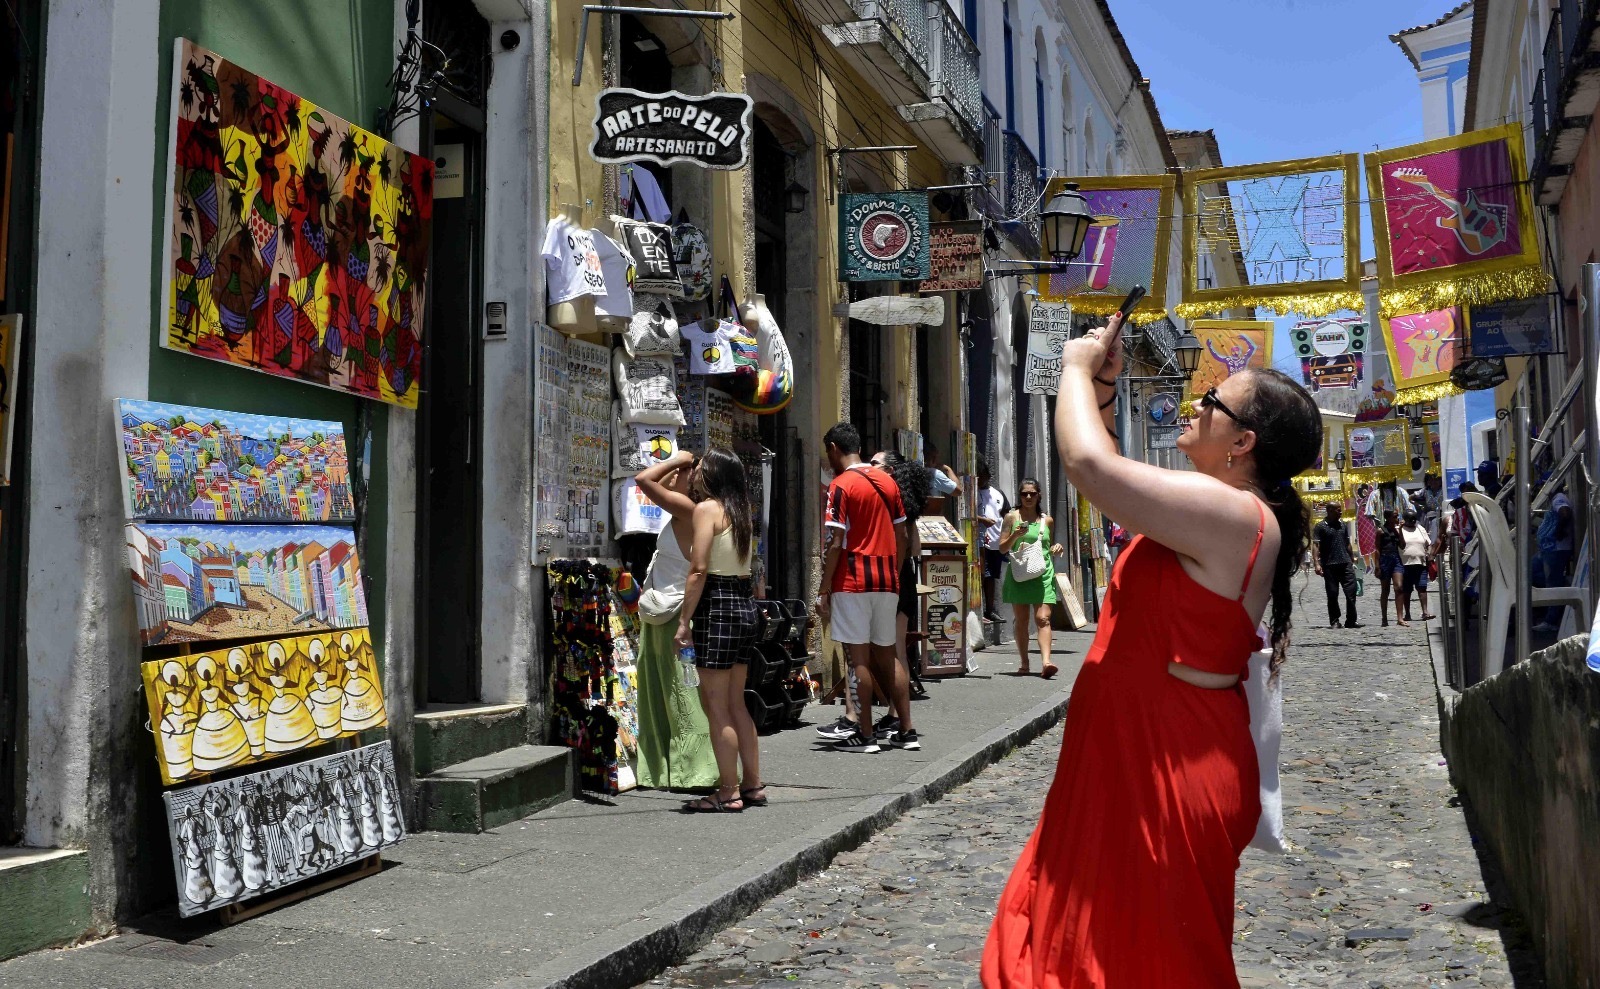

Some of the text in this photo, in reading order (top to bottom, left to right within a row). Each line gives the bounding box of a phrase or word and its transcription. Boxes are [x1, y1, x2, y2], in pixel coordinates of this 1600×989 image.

[602, 102, 739, 147] ARTE DO PELÔ
[615, 137, 716, 156] ARTESANATO
[851, 200, 922, 259] Donna Pimenta
[847, 226, 868, 264] Burgers
[1475, 320, 1504, 328] GRUPO
[1507, 318, 1518, 326] DE
[1031, 357, 1062, 372] FILHOS
[931, 574, 957, 584] EXECUTIVO
